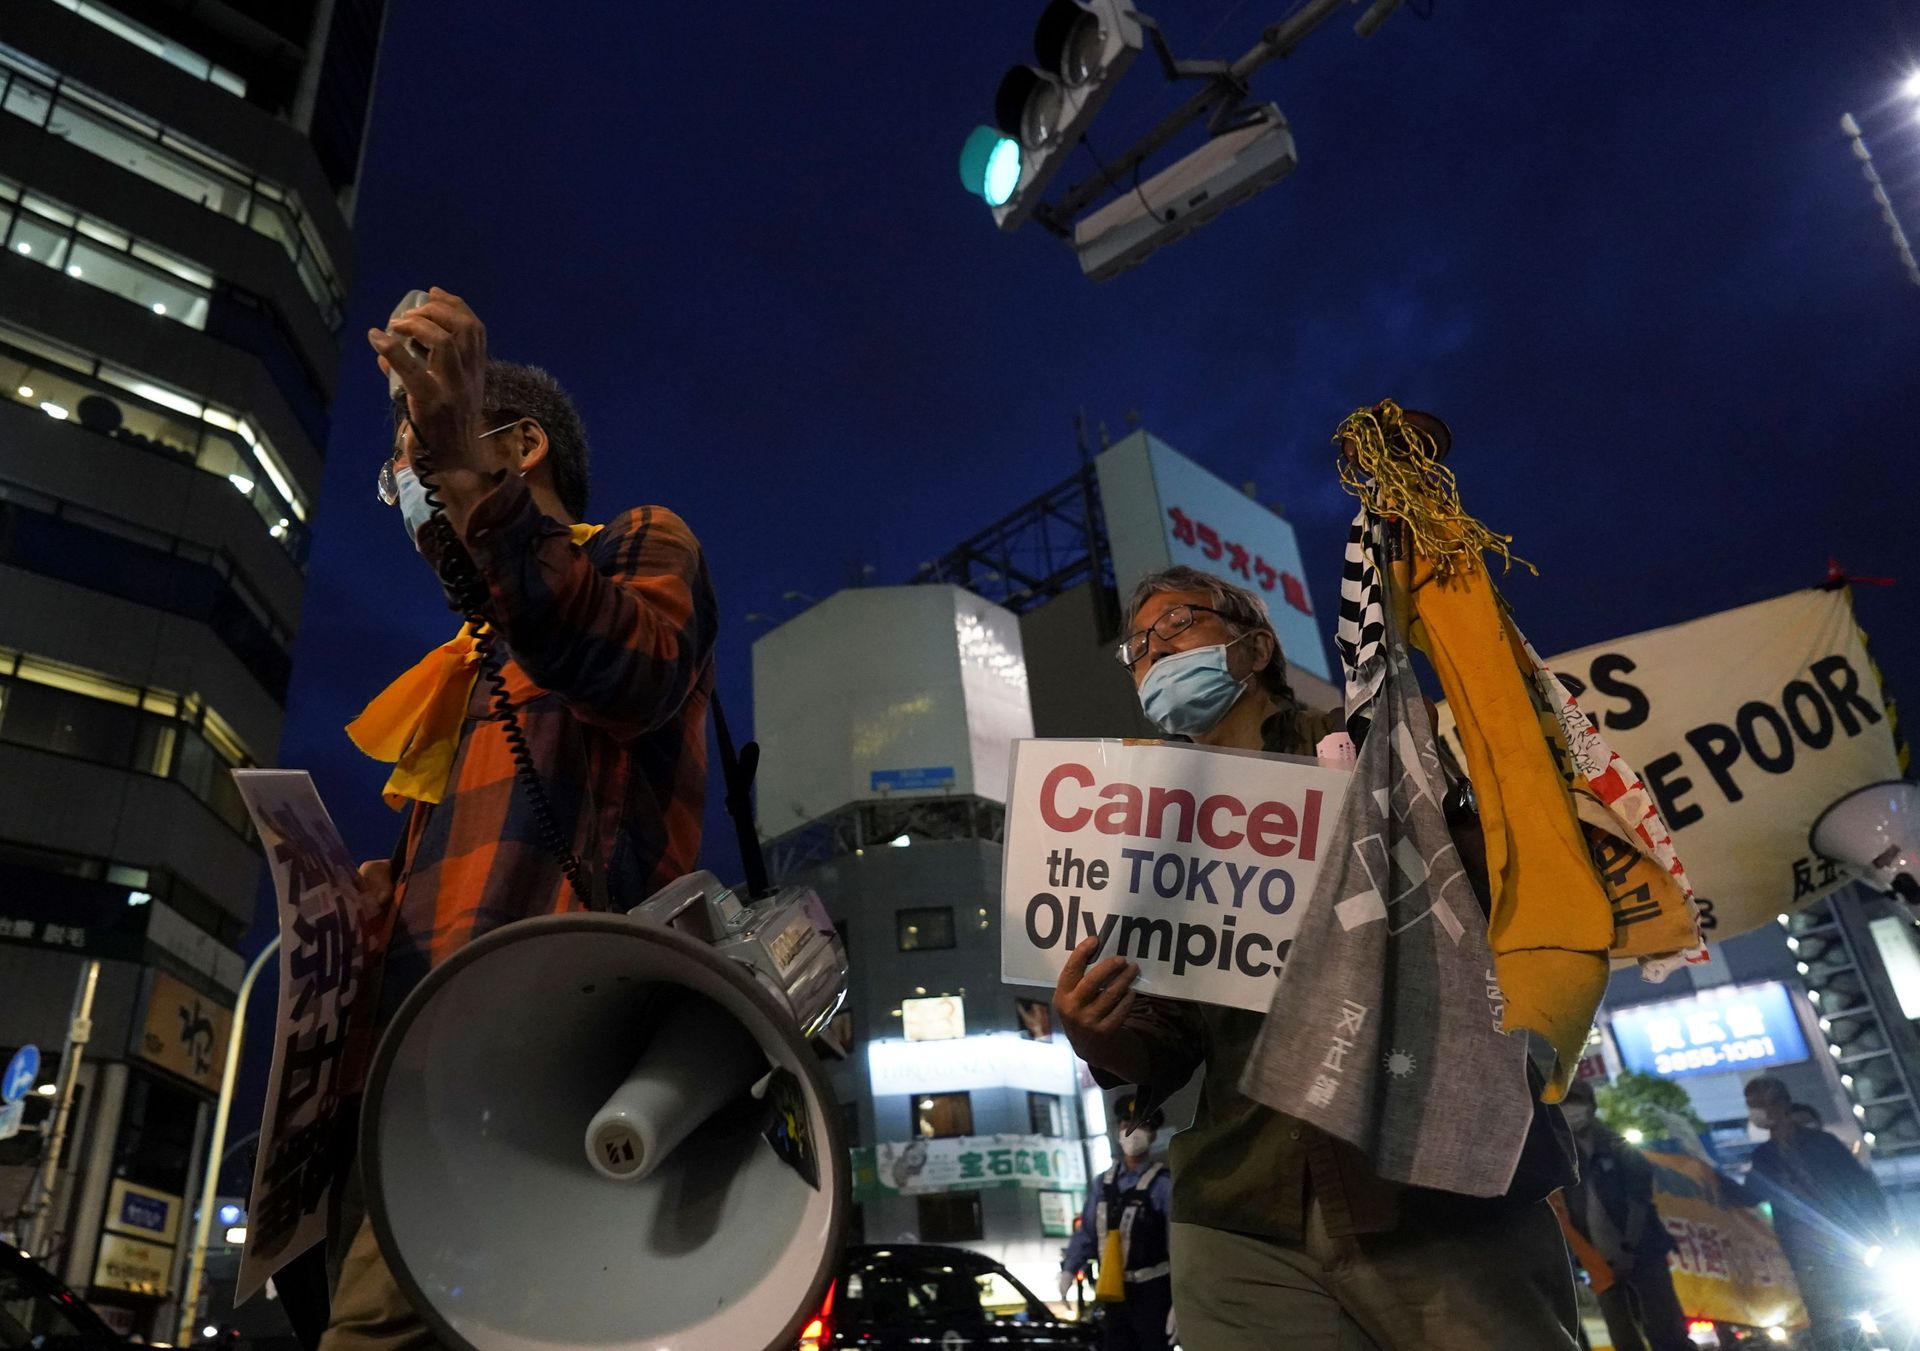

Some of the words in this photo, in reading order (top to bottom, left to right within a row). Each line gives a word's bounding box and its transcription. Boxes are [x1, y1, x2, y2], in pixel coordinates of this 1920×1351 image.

[1685, 655, 1882, 802] POOR
[1040, 763, 1323, 861] Cancel
[1046, 848, 1109, 890] the
[1121, 848, 1296, 915] TOKYO
